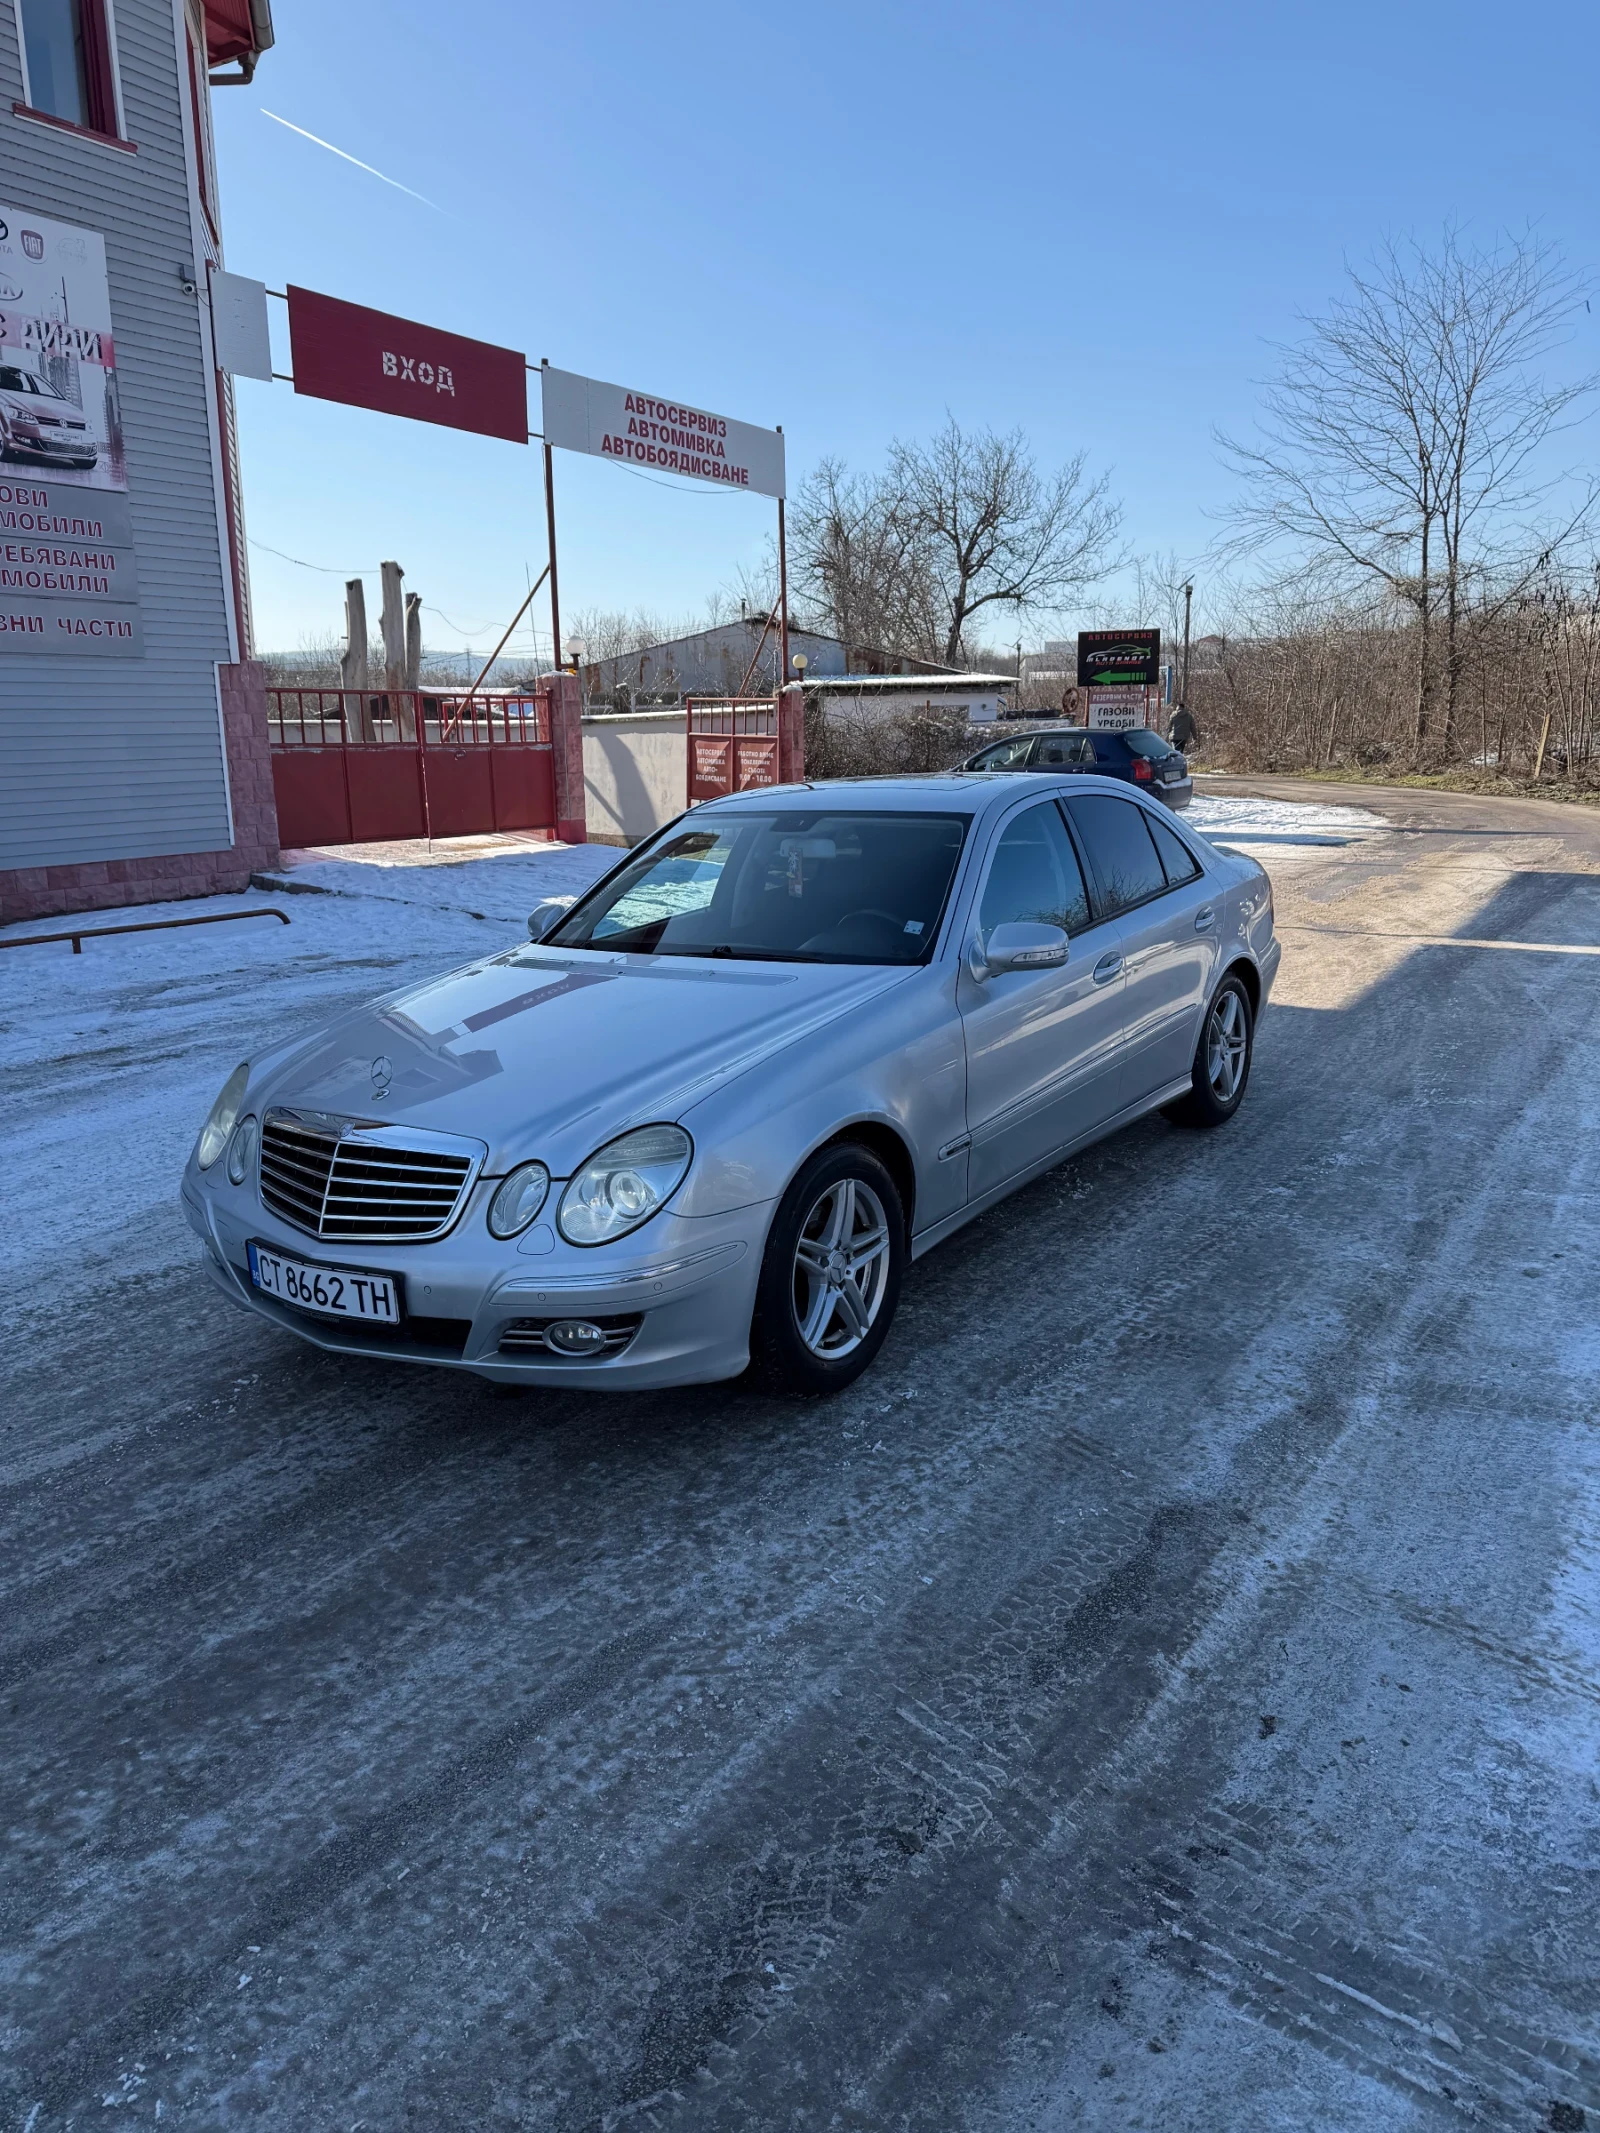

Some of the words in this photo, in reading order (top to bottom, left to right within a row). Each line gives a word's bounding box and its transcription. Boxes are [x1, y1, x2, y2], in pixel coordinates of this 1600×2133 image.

[23, 234, 42, 255] FIAT
[21, 317, 103, 360] ДИДИ
[382, 351, 455, 397] ВХОД
[624, 393, 727, 438] АВТОСЕРВИЗ
[627, 417, 726, 458] АВТОМИВКА
[601, 434, 749, 485] АВТОБОЯДИСВАНЕ
[0, 545, 115, 571] ЕБЯВАНИ
[1, 569, 109, 594] МОБИЛИ
[57, 617, 133, 638] ЧАСТИ
[1088, 632, 1153, 641] АВТОСЕРВИЗ
[1097, 707, 1135, 716] ГАЗОВИ
[1097, 719, 1135, 728] УРЕДБИ
[260, 1255, 281, 1292] CT
[286, 1266, 347, 1310] 8662
[351, 1279, 391, 1316] TH
